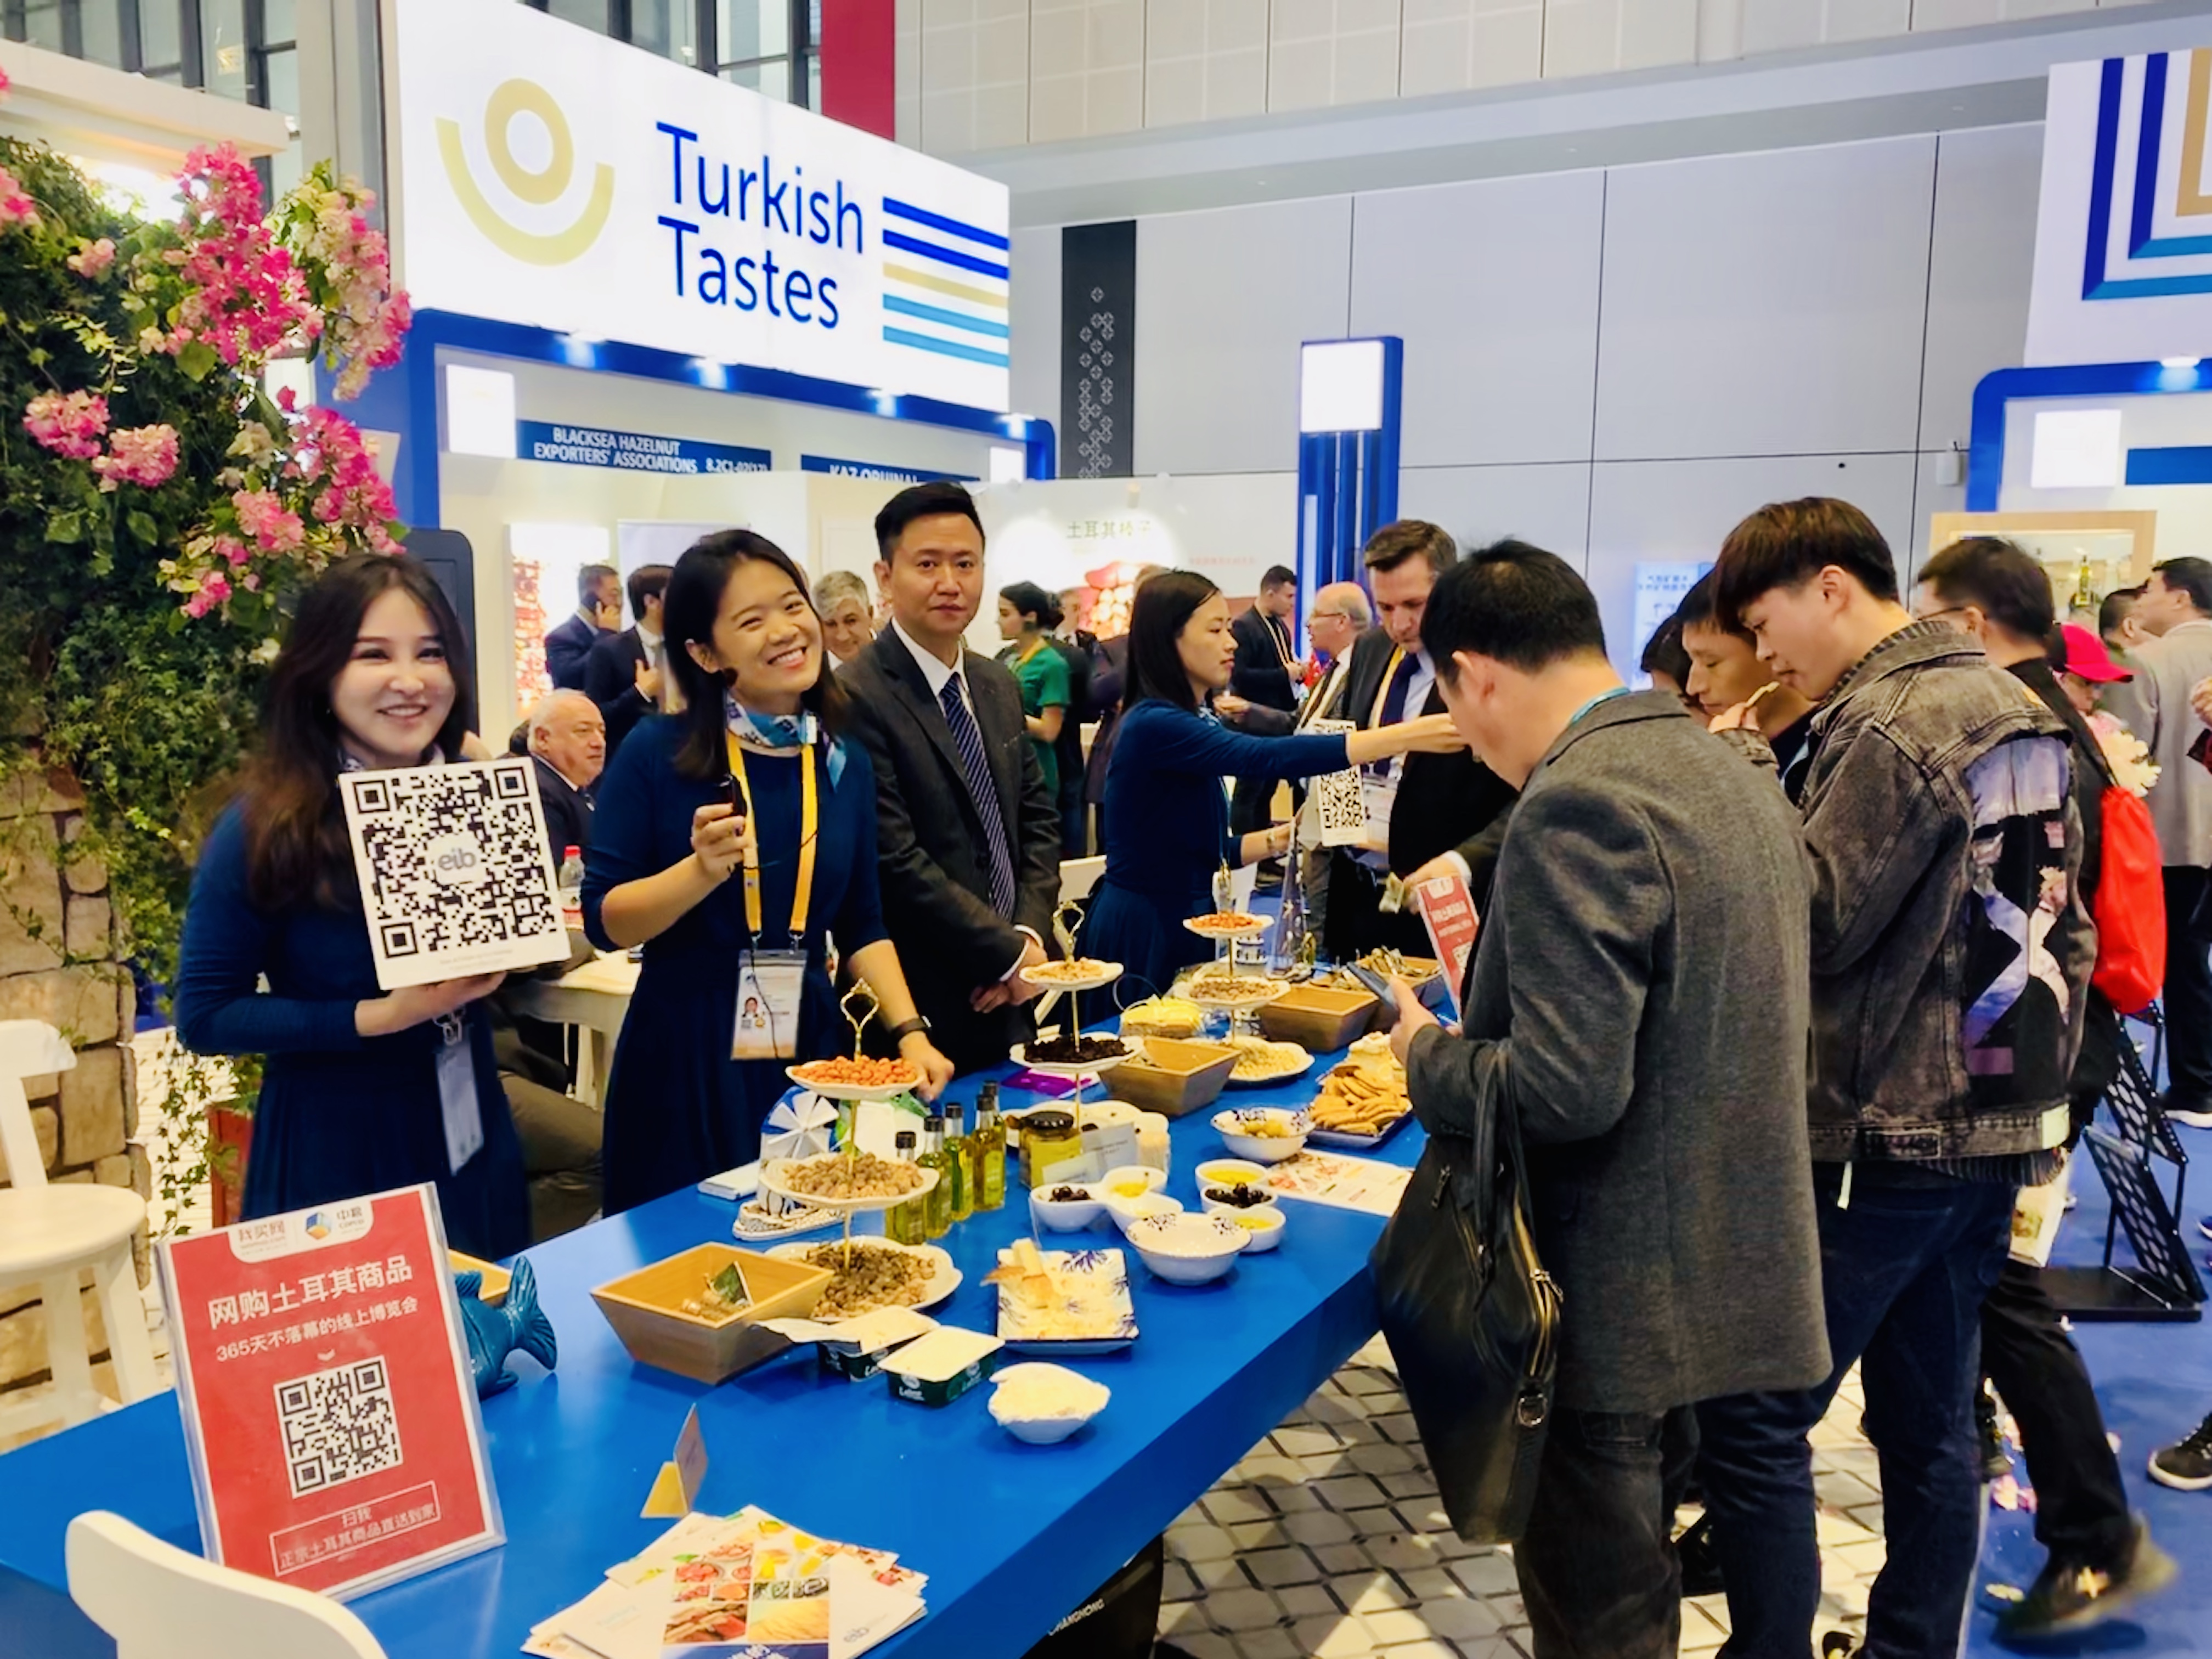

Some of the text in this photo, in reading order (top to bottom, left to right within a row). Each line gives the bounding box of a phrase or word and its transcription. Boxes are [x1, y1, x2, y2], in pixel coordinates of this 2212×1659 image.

[656, 121, 863, 254] Turkish
[657, 215, 839, 329] Tastes
[533, 442, 698, 473] EXPORTERS' ASSOCIATIONS
[552, 427, 681, 456] BLACKSEA HAZELNUT
[207, 1254, 413, 1330] 网购土耳其商品
[216, 1296, 419, 1362] 365天不落幕的线上博览会
